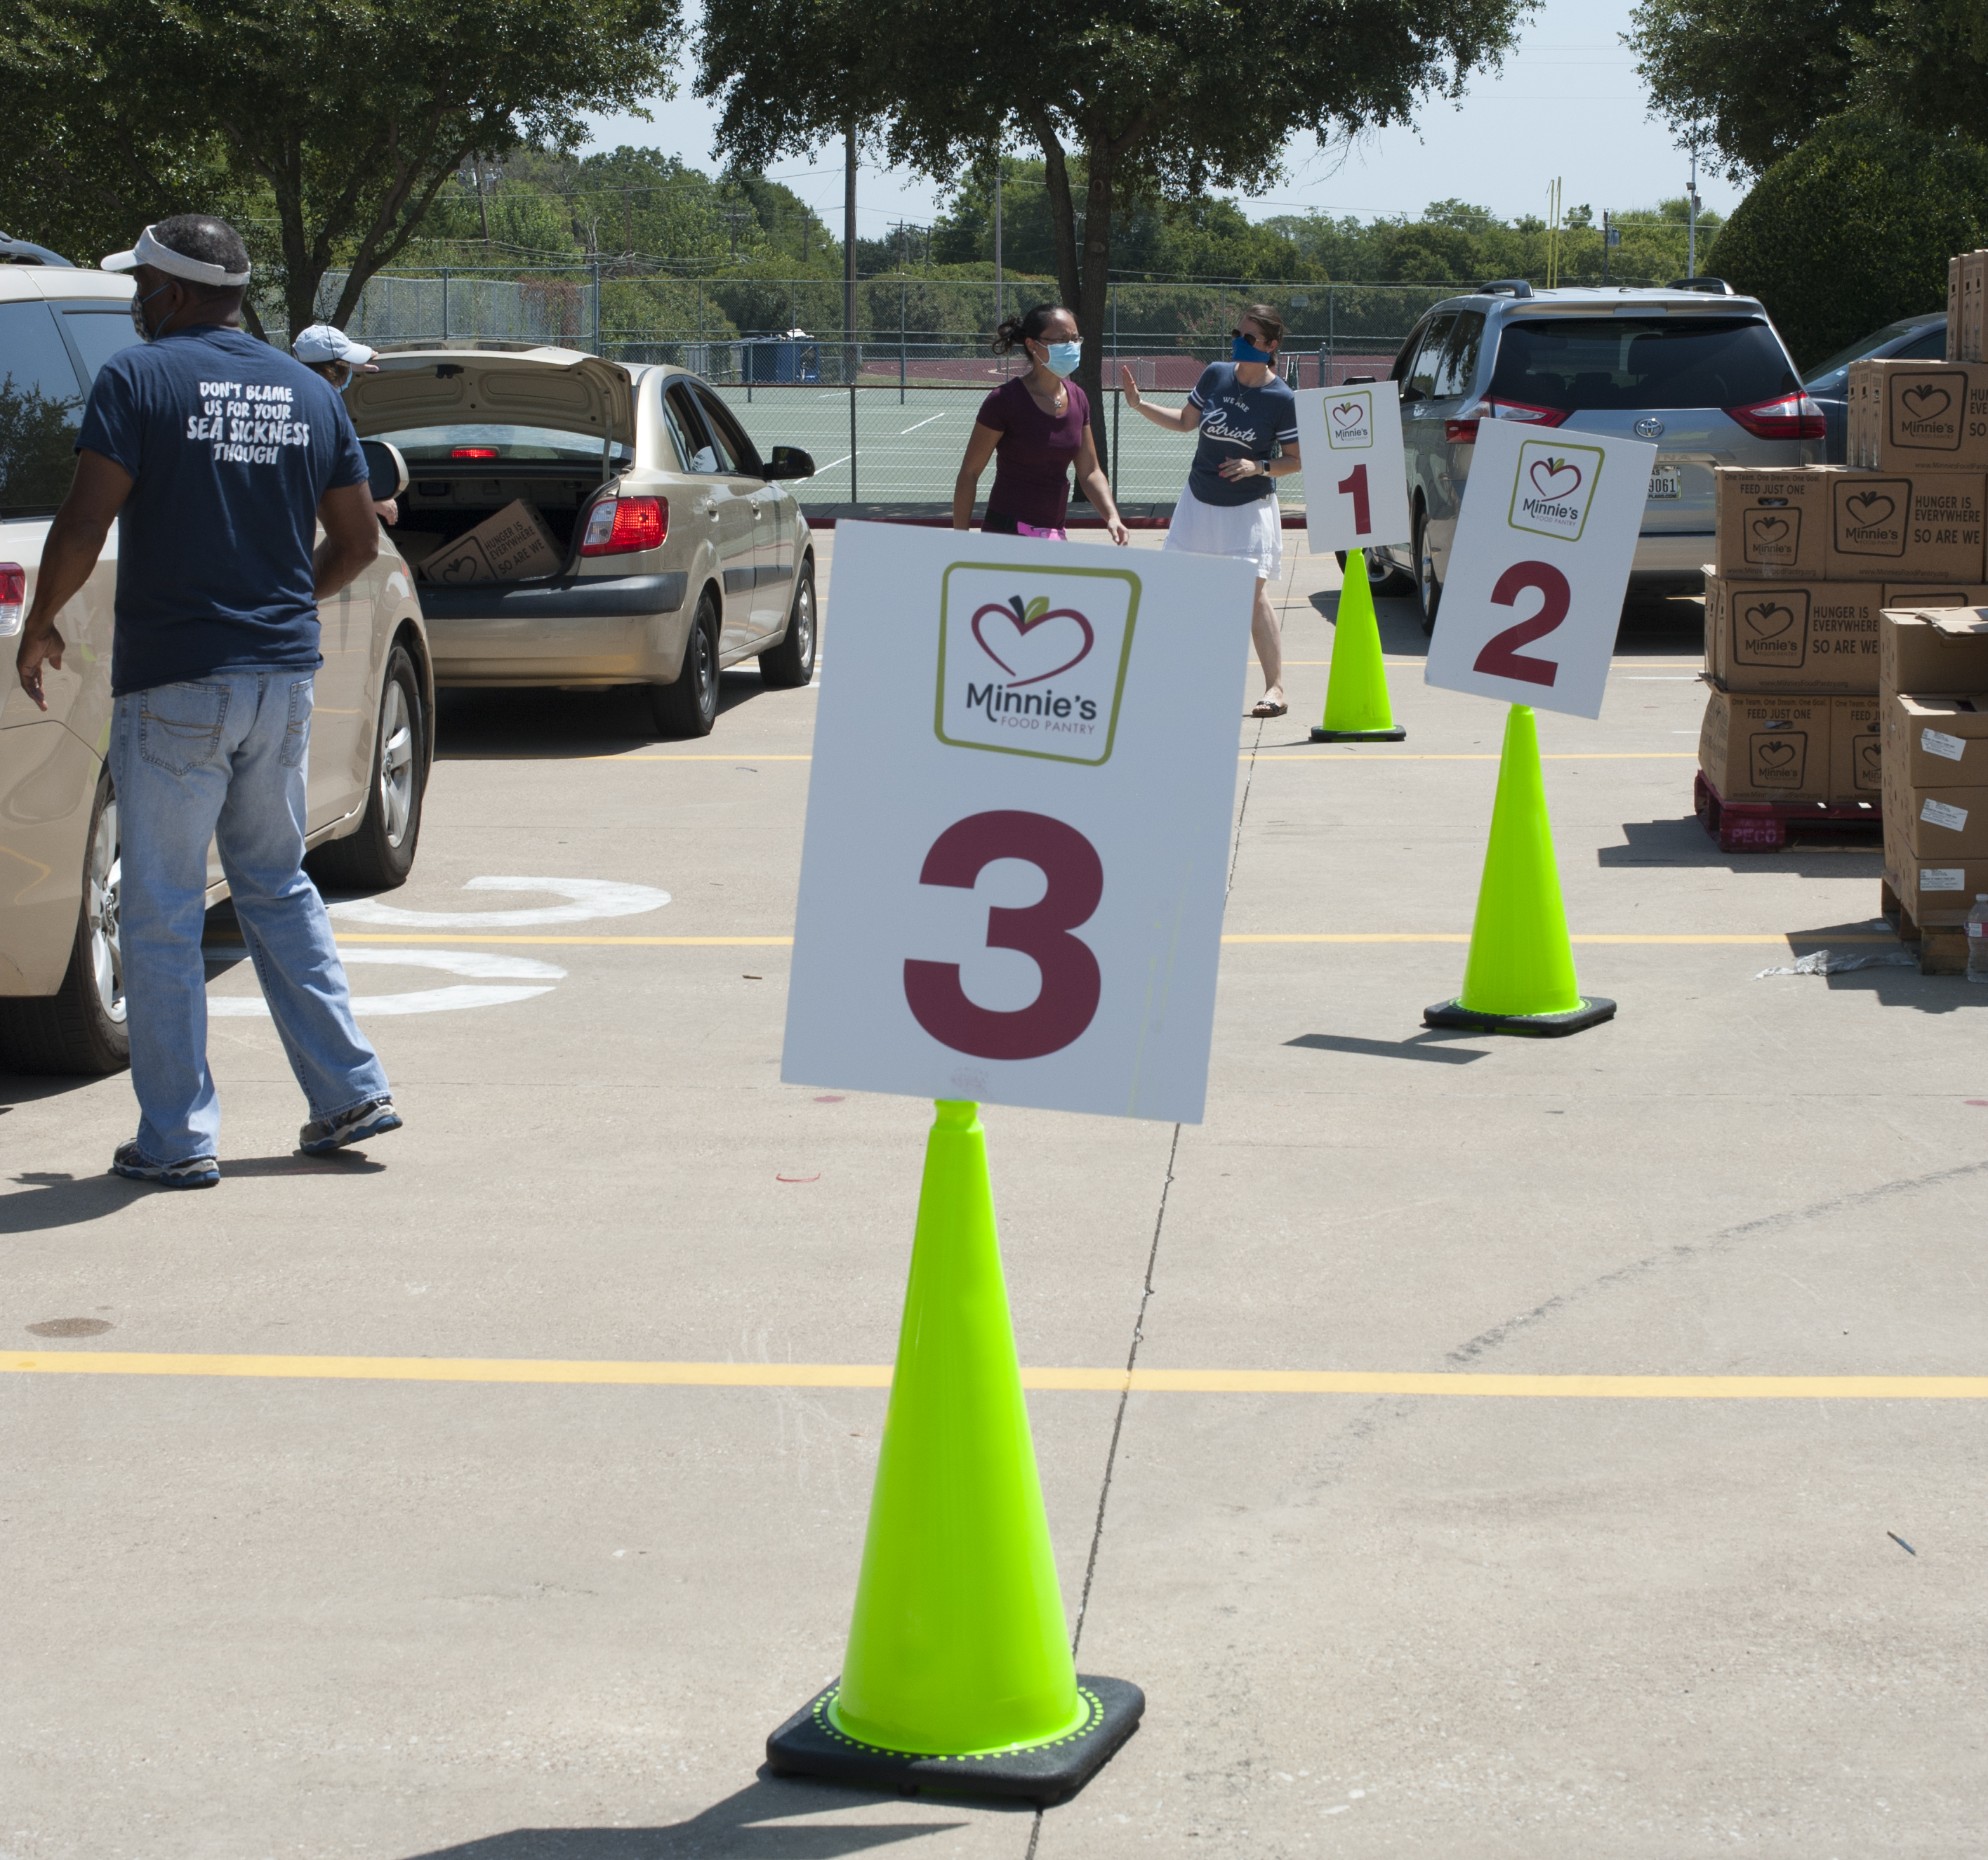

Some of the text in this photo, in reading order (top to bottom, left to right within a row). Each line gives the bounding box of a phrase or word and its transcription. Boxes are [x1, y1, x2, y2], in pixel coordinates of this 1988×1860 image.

[199, 381, 293, 402] DON'T BLAME
[204, 400, 291, 420] US FOR YOUR
[187, 416, 310, 447] SEA SICKNESS
[1200, 407, 1257, 442] Patriots
[1902, 421, 1954, 437] Minnie's
[1969, 422, 1987, 436] SO
[1335, 428, 1368, 441] Minnie's
[213, 442, 279, 464] THOUGH
[1740, 484, 1805, 495] FEED JUST ONE
[1338, 463, 1372, 535] 1
[1915, 496, 1971, 509] HUNGER IS
[1523, 498, 1579, 520] Minnie's
[1915, 509, 1980, 522] EVERYWHERE
[1536, 515, 1577, 527] FOOD PANTRY
[484, 521, 524, 552] HUNGER IS
[489, 526, 536, 560] EVERYWHERE
[1845, 527, 1898, 543] Minnie's
[1914, 529, 1980, 545] SO ARE WE
[498, 539, 545, 575] SO ARE WE
[1753, 543, 1792, 555] Minnie's
[1813, 606, 1869, 619] HUNGER IS
[1472, 560, 1571, 687] 2
[1813, 619, 1878, 632] EVERYWHERE
[1745, 639, 1798, 655] Minnie's
[1813, 640, 1878, 654] SO ARE WE
[966, 682, 1096, 723] Minnie's
[1747, 708, 1811, 719] FEED JUST ONE
[1851, 711, 1871, 720] FEED
[1000, 715, 1095, 735] FOOD PANTRY
[1758, 768, 1798, 780] Minnie's
[1732, 829, 1777, 843] PECO
[903, 809, 1104, 1061] 3
